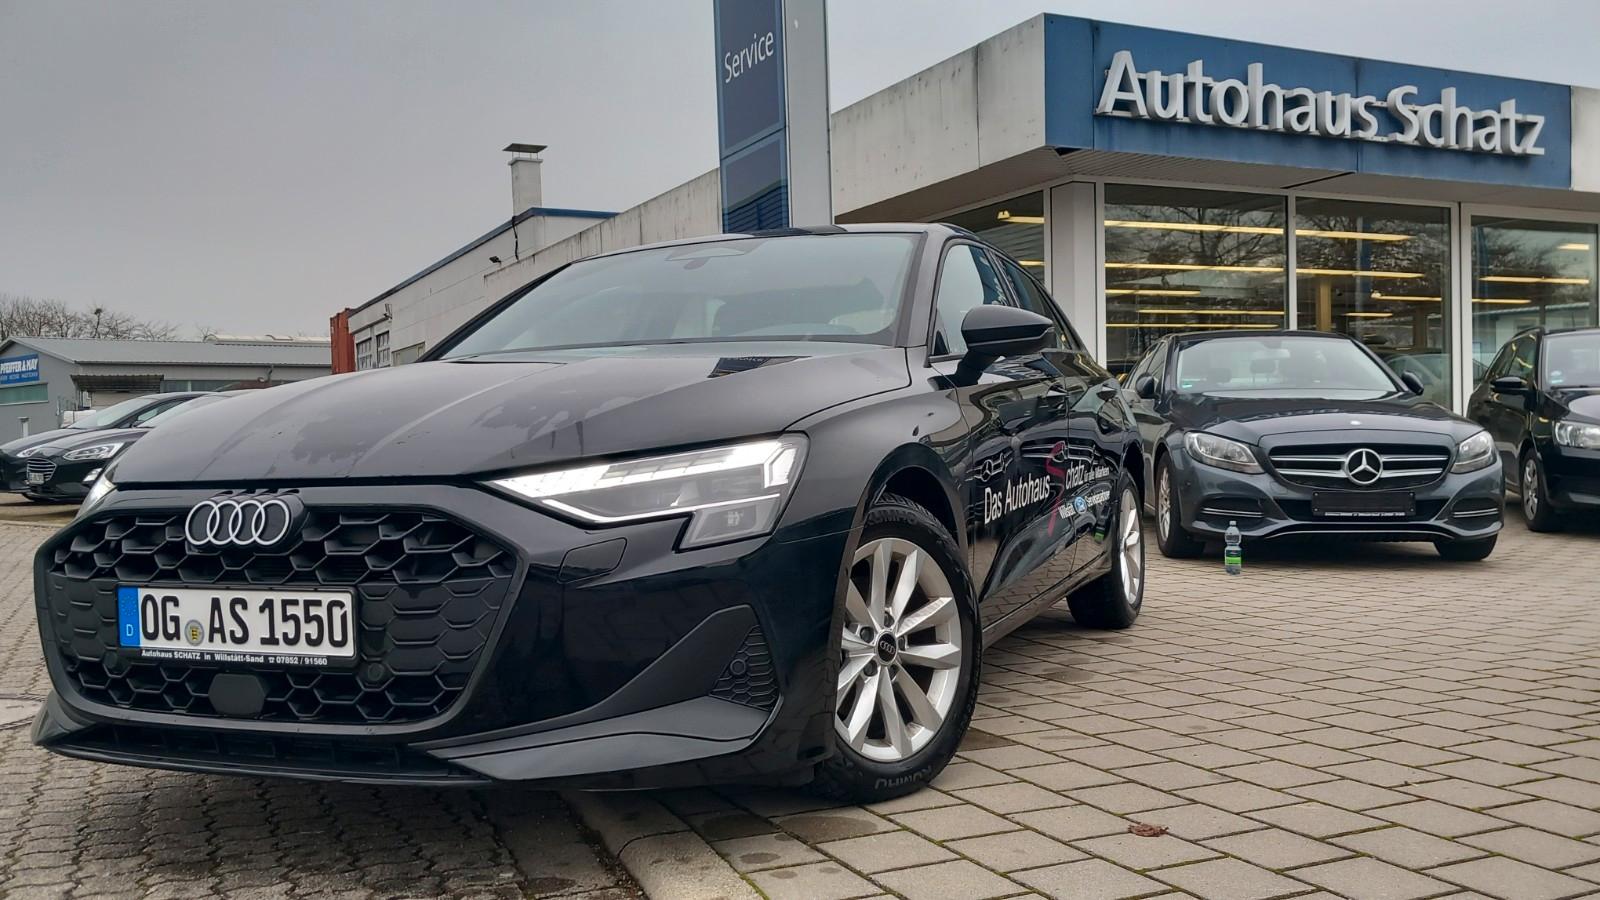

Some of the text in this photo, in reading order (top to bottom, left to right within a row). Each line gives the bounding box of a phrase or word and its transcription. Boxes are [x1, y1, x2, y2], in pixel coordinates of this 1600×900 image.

[724, 31, 774, 84] Service
[1095, 49, 1545, 156] Autohaus Schatz
[984, 487, 1003, 525] Das
[1004, 473, 1051, 515] Autohaus
[126, 623, 134, 637] D
[141, 594, 348, 648] OG AS 1550
[141, 649, 173, 658] Autohaus
[174, 650, 201, 660] SCHATZ
[204, 652, 211, 660] in
[214, 653, 264, 664] Willstätt-Sand
[275, 655, 299, 665] 07852
[304, 656, 328, 666] 91560
